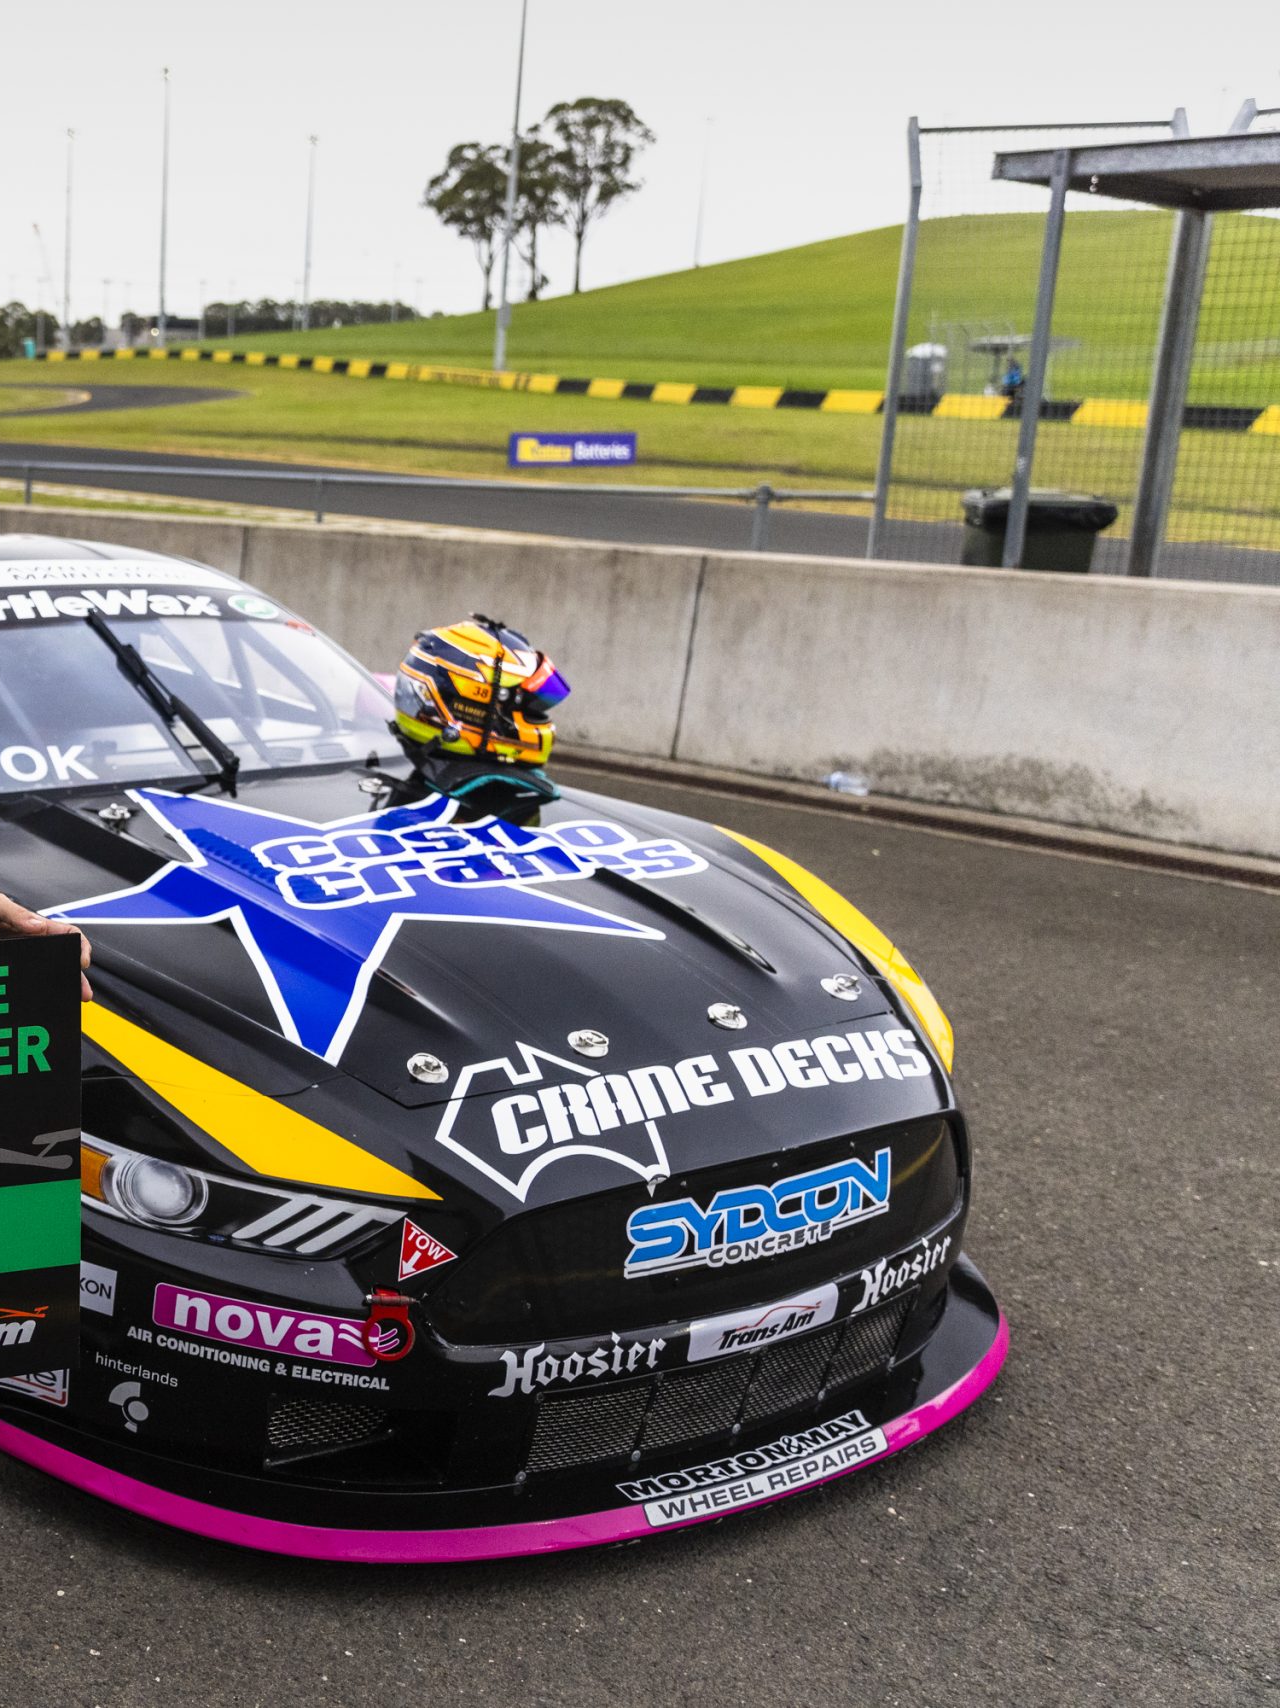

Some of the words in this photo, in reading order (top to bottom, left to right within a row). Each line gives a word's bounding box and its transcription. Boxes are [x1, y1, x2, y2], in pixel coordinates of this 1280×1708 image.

[490, 1053, 734, 1155] CRANE
[728, 1028, 932, 1099] DECKS
[626, 1147, 892, 1265] SYDCON
[407, 1226, 447, 1260] TOW
[707, 1220, 833, 1268] CONCRETE
[851, 1235, 953, 1314] Hoosier
[127, 1325, 153, 1343] AIR
[156, 1334, 271, 1372] CONDITIONING
[275, 1363, 288, 1376] &
[292, 1366, 390, 1390] ELECTRICAL
[173, 1293, 335, 1357] nova
[718, 1322, 777, 1352] Trans
[774, 1310, 817, 1341] Am
[95, 1351, 179, 1387] hinterlands
[488, 1331, 666, 1398] Hoosier
[658, 1482, 764, 1520] WHEEL
[766, 1435, 879, 1490] REPAIRS
